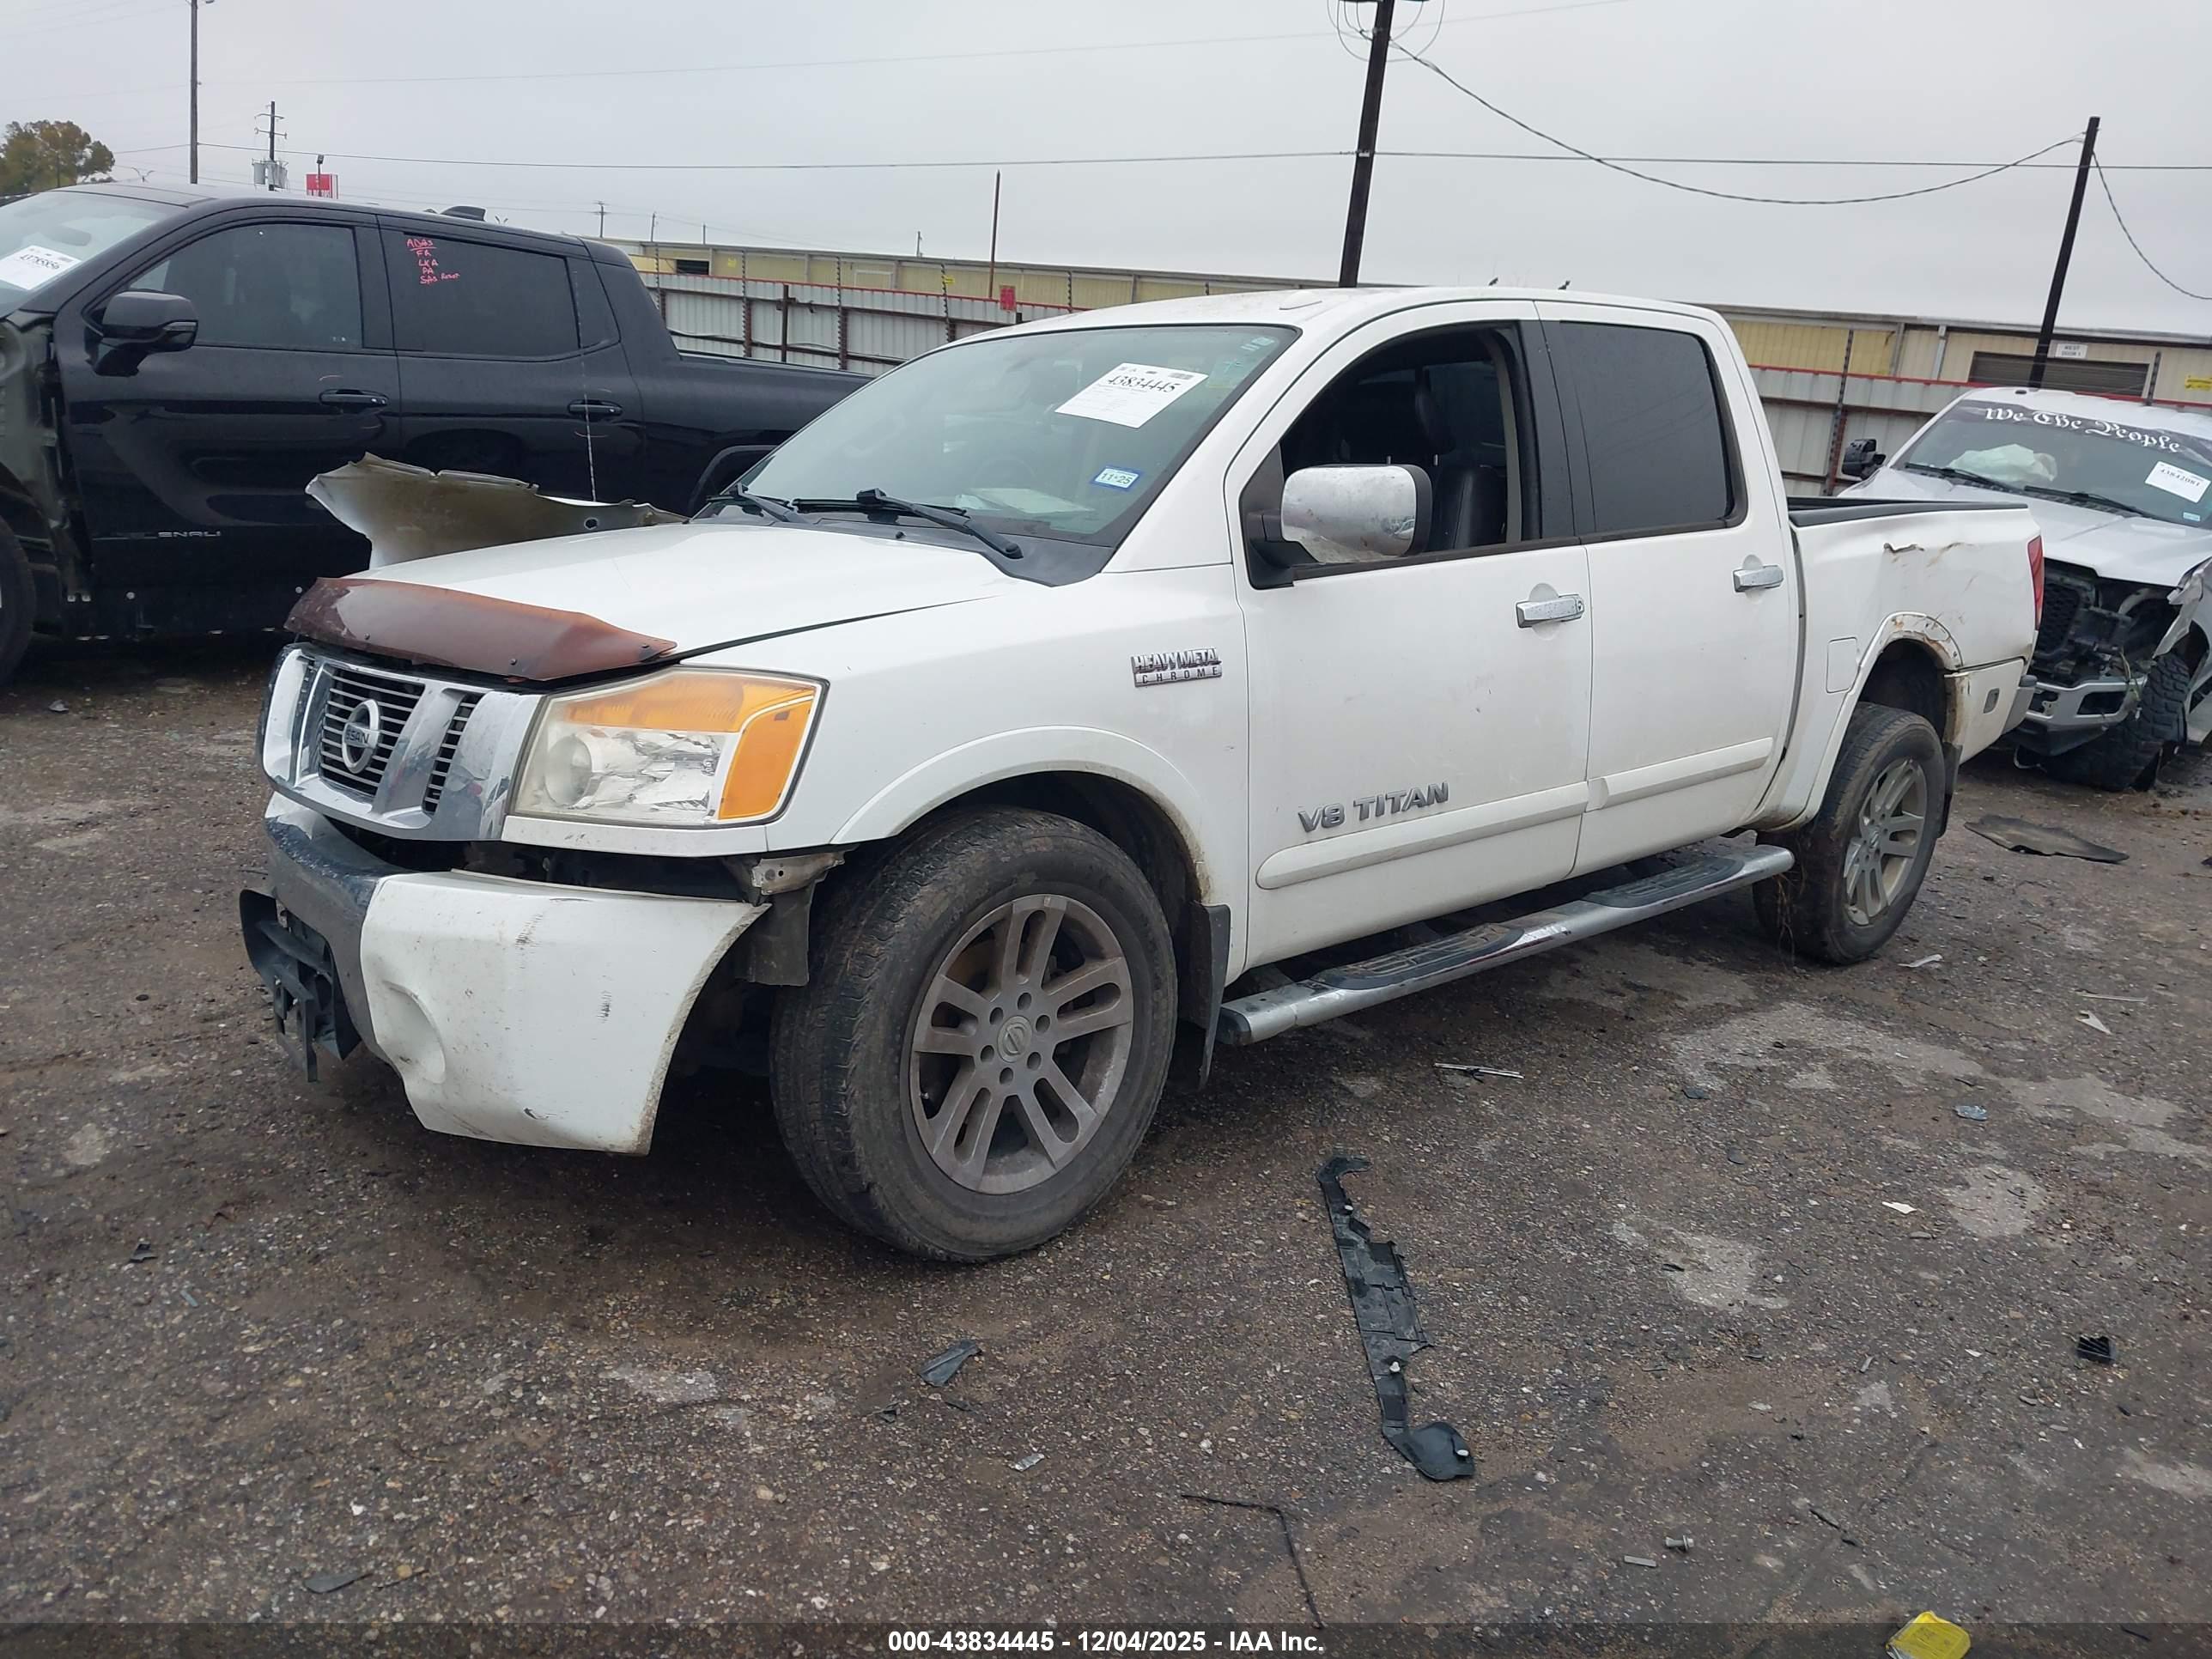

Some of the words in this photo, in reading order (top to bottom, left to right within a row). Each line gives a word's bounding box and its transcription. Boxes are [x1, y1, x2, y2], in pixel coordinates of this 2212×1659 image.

[1108, 374, 1181, 393] 43834445
[1985, 407, 2024, 422] We
[2032, 410, 2082, 429] The
[2085, 420, 2180, 453] People
[1132, 652, 1182, 672] HEAVY
[1142, 665, 1218, 684] CHROME
[1298, 802, 1346, 833] V8
[1353, 782, 1449, 821] TITAN
